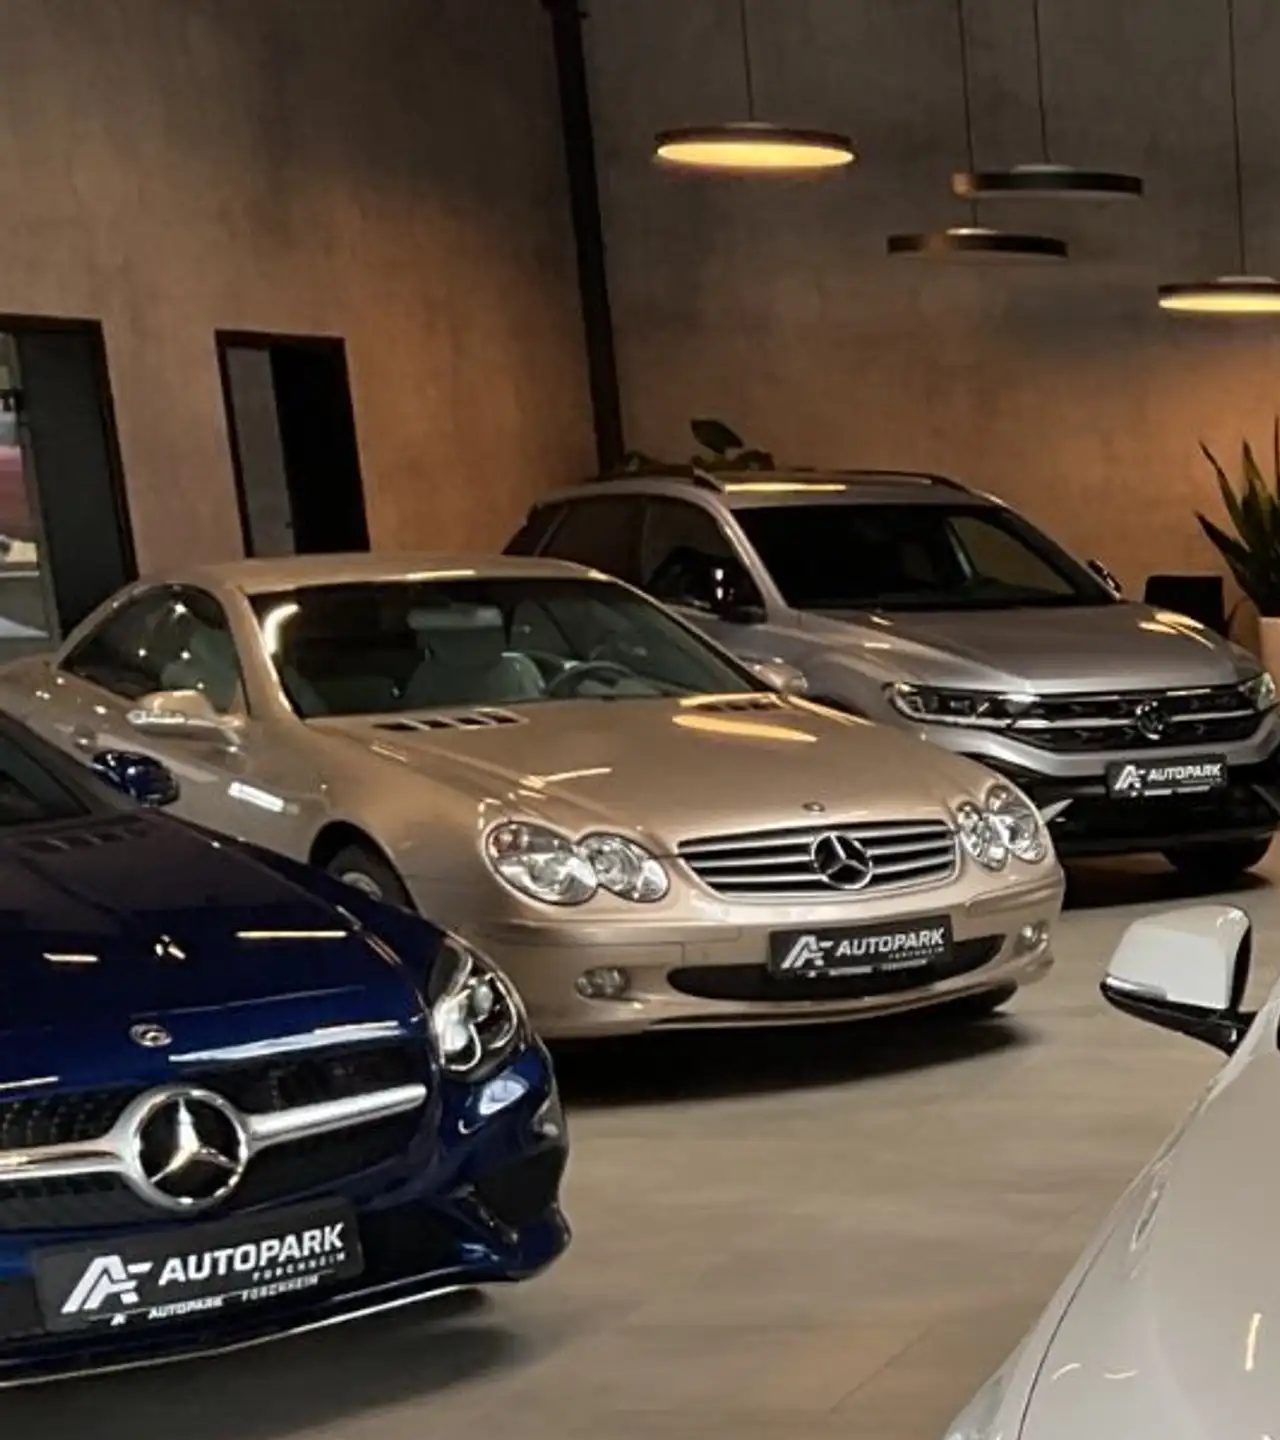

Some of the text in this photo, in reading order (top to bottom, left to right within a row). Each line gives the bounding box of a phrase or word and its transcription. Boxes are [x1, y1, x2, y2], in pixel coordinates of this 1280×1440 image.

[1147, 763, 1223, 783] AUTOPARK
[835, 927, 945, 957] AUTOPARK
[158, 1221, 345, 1286] AUTOPARK
